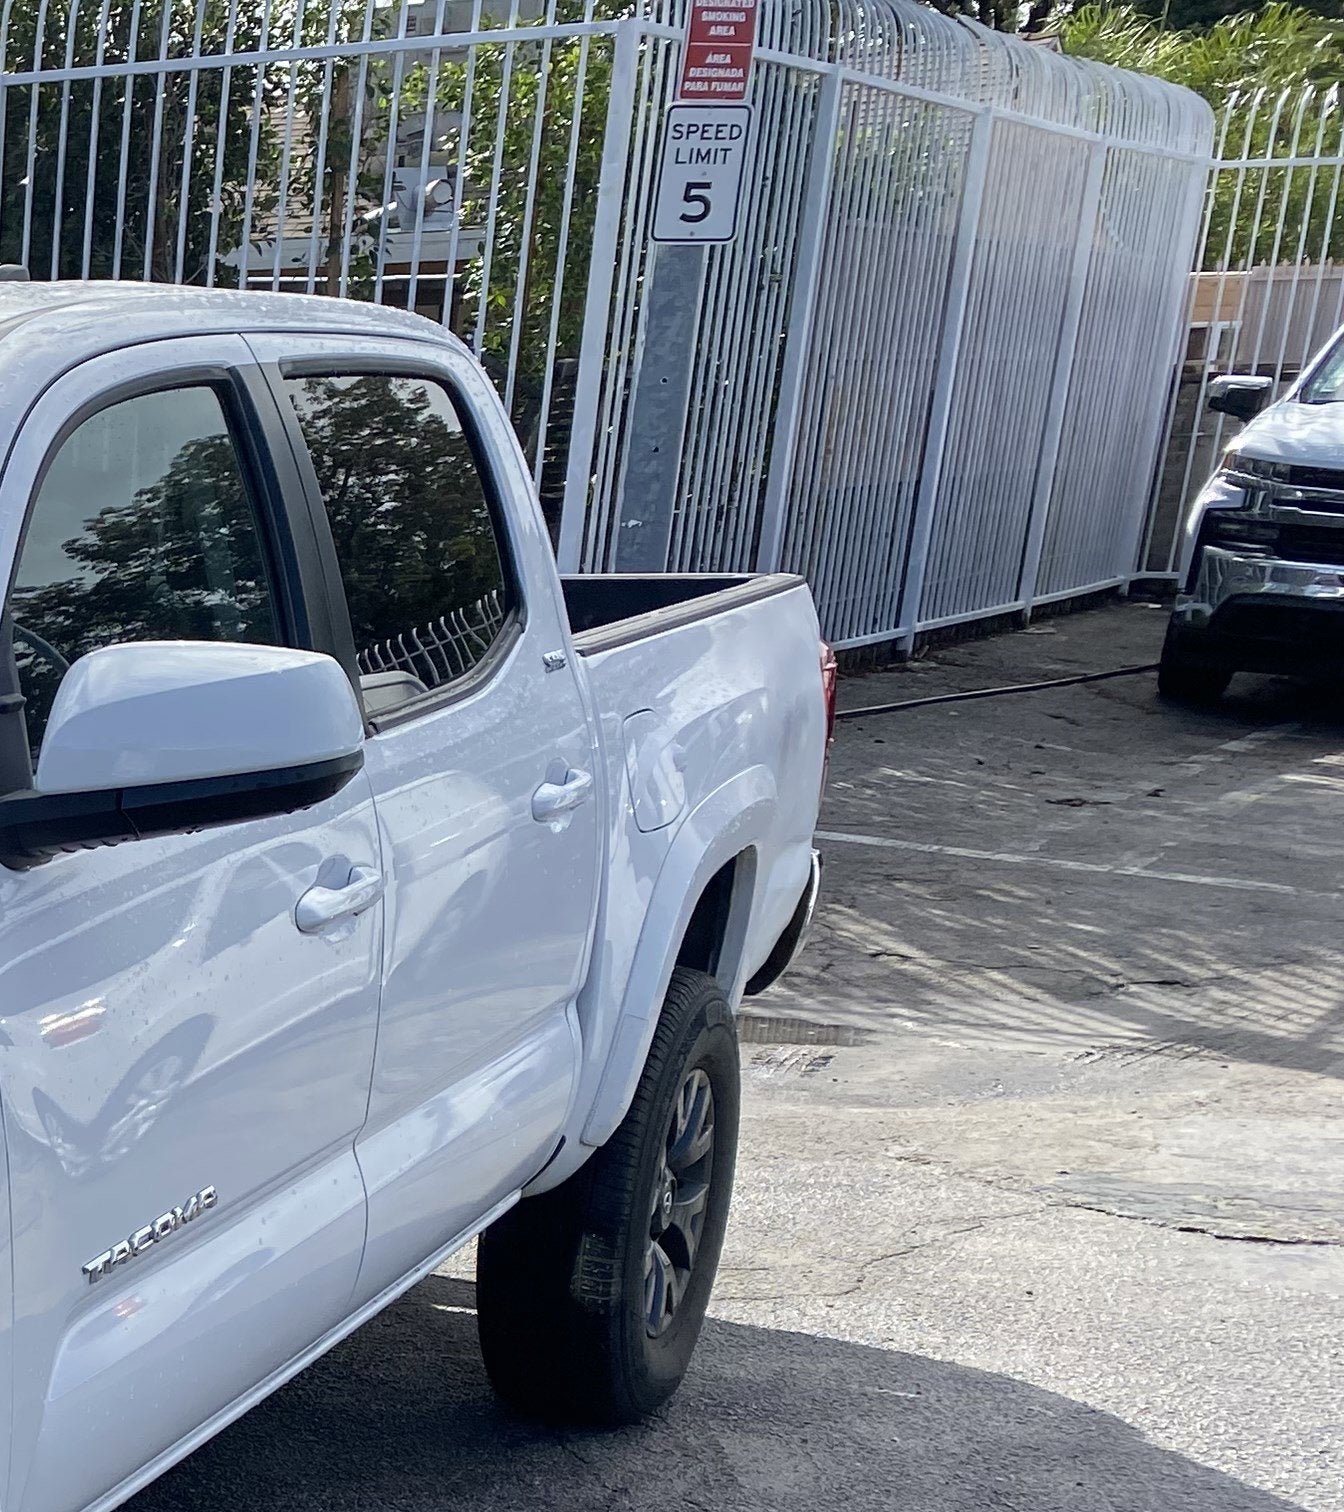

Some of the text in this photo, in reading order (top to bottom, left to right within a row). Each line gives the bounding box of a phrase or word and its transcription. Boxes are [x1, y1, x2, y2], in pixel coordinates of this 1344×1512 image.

[701, 11, 746, 22] SMOKING
[708, 25, 735, 36] AREA
[689, 67, 744, 78] DESIGNADA
[683, 81, 745, 92] PARA FUMAR
[672, 123, 743, 141] SPEED
[675, 148, 732, 165] LIMIT
[679, 182, 712, 223] 5
[81, 1184, 218, 1285] TACOMA
